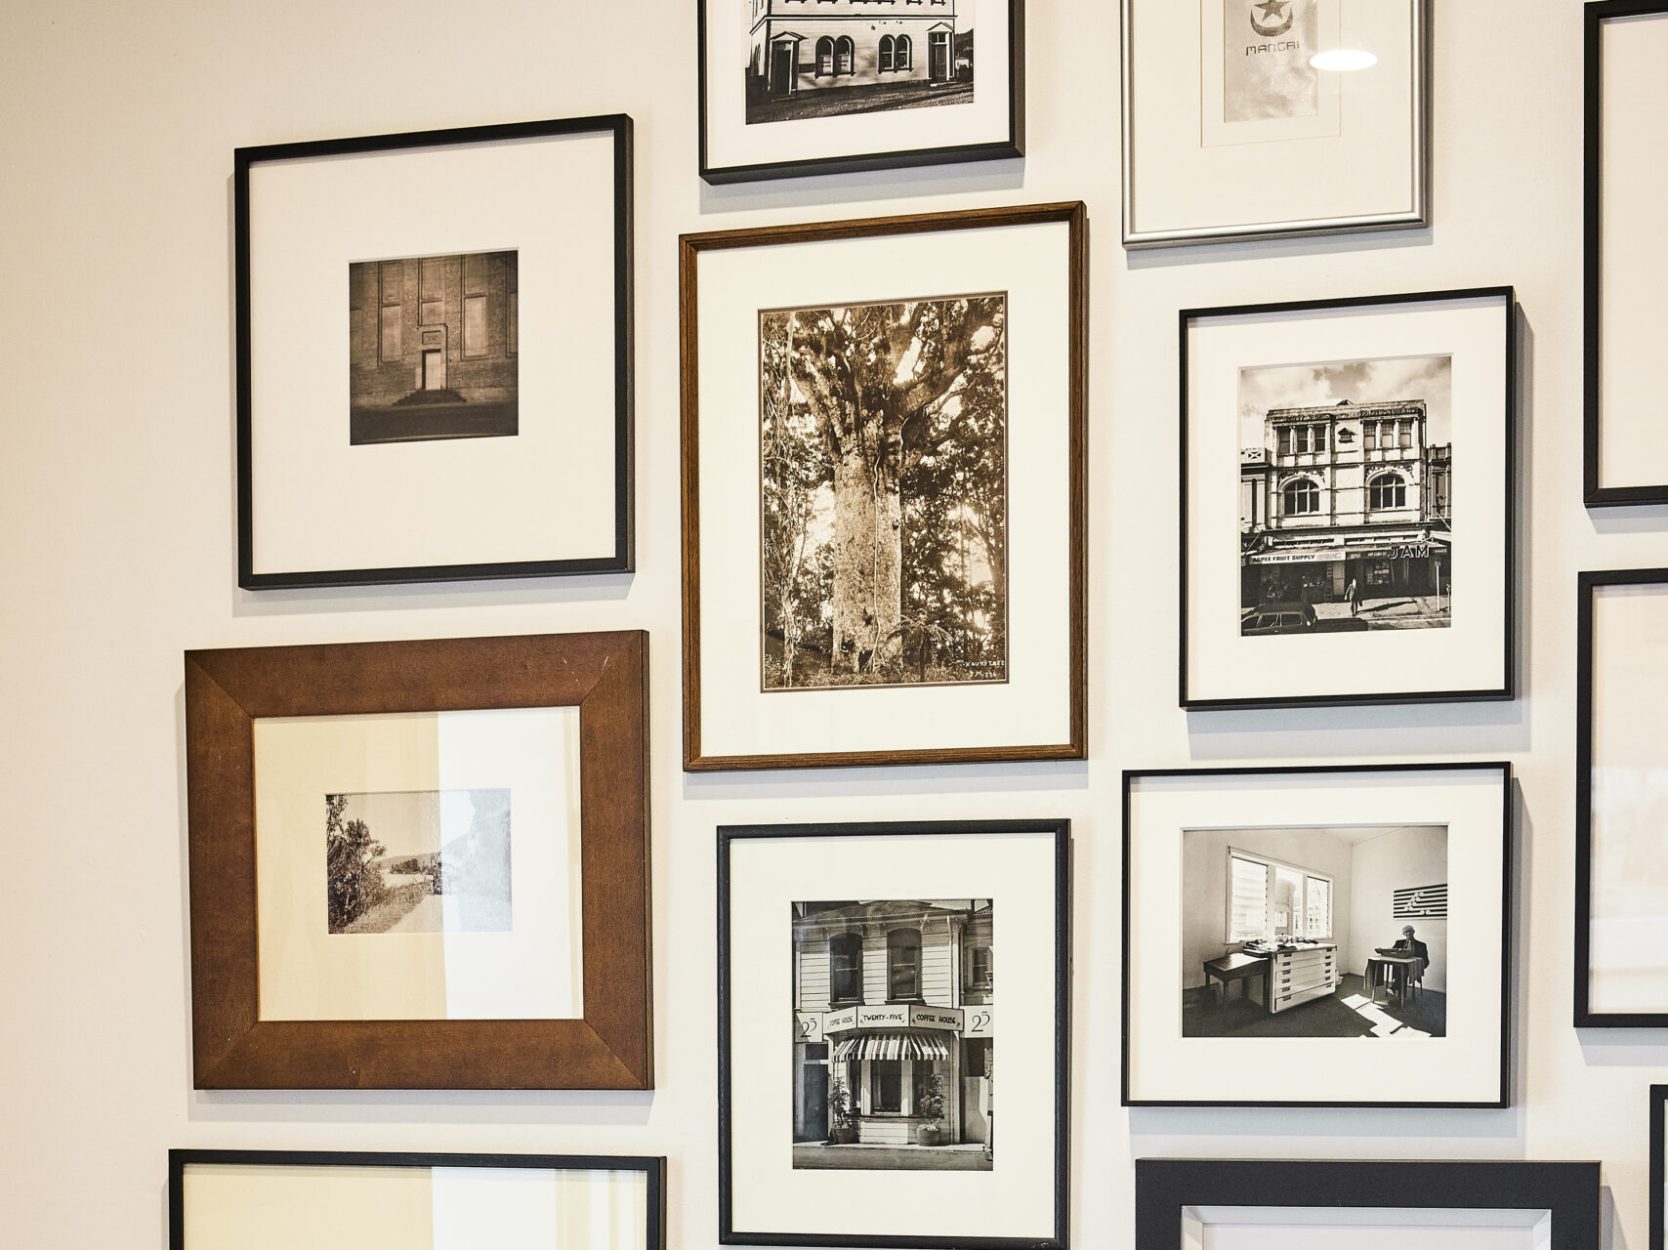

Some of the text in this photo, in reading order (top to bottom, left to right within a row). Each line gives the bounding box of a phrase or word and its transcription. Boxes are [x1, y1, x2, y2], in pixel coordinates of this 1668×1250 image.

[1387, 545, 1430, 559] JAM
[916, 1013, 956, 1024] COFFEE HOUSE
[971, 1011, 991, 1032] 25
[800, 1017, 817, 1038] 25
